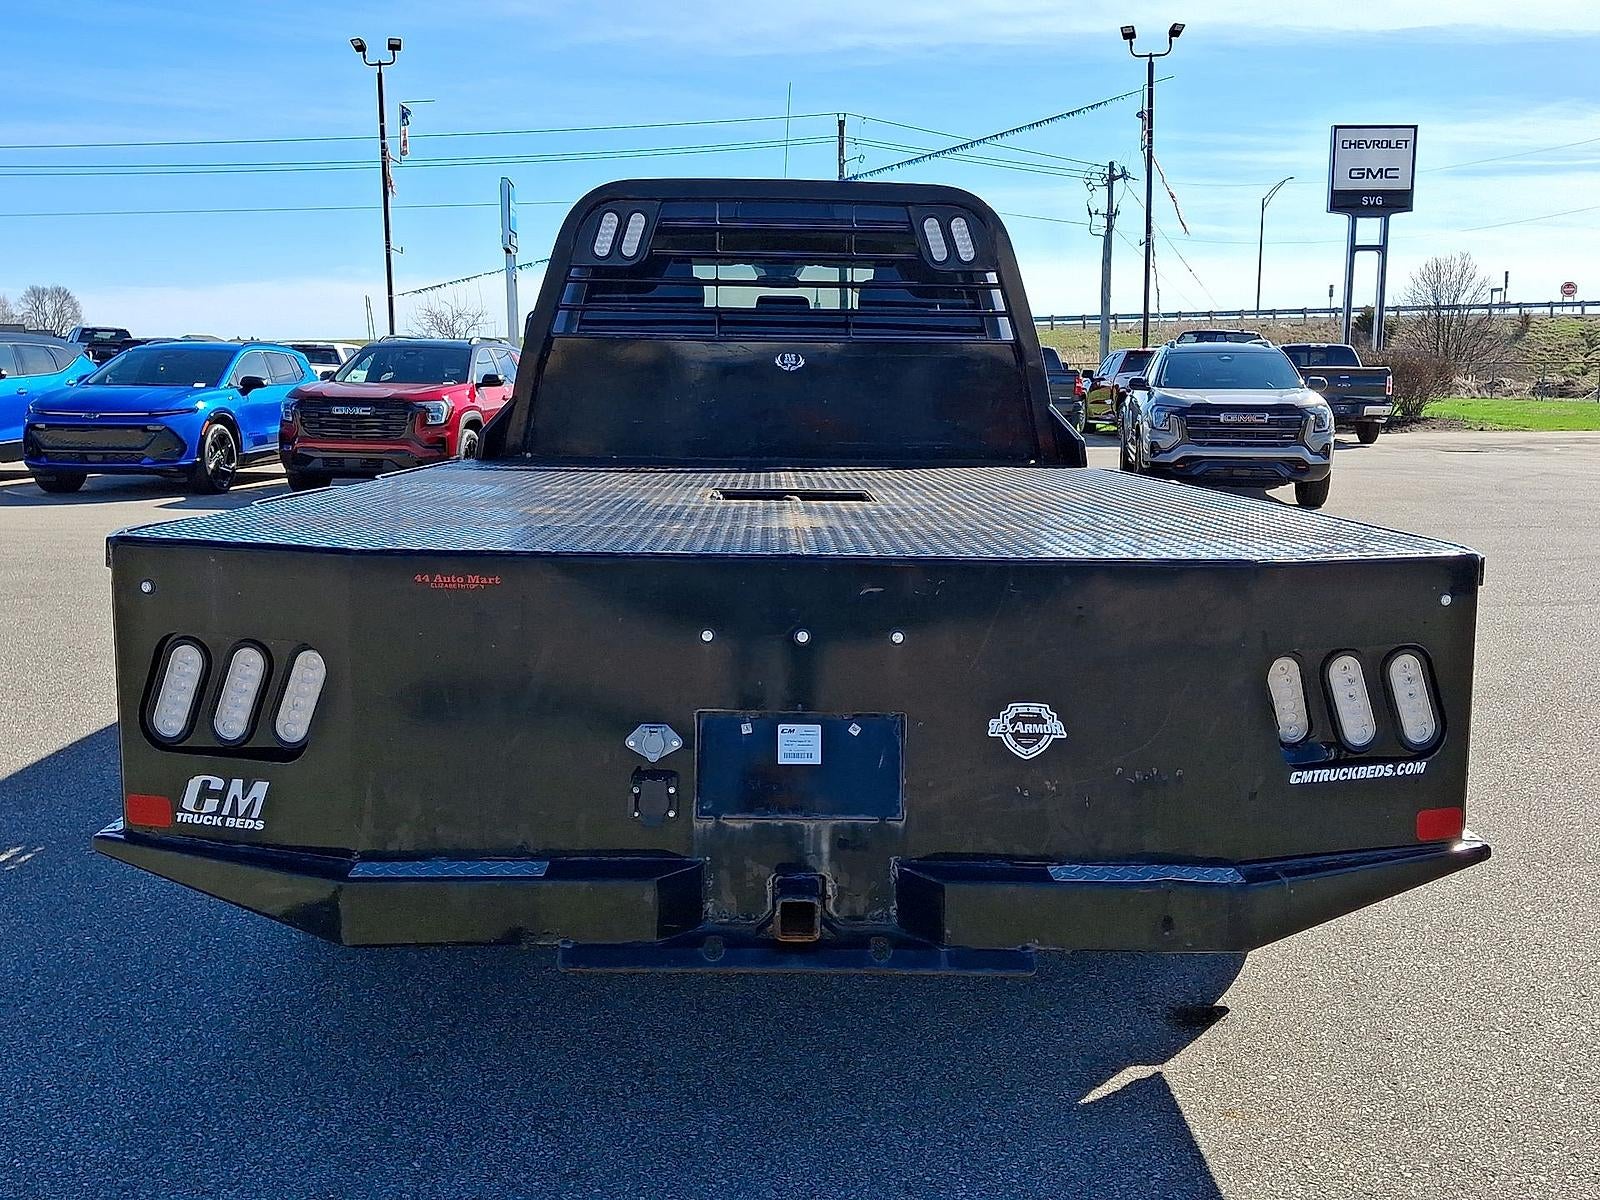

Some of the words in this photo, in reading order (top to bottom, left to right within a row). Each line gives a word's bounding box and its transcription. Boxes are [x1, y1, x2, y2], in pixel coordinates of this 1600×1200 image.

[1341, 139, 1411, 150] CHEVROLET
[1348, 167, 1400, 180] GMC
[1361, 196, 1383, 206] SVG
[331, 406, 371, 415] GMC
[1223, 413, 1266, 424] GMC
[414, 574, 430, 583] 44
[433, 574, 465, 583] Auto
[467, 574, 501, 585] Mart
[1289, 761, 1427, 784] CMTRUCKBEDS.COM
[181, 774, 270, 819] CM
[175, 812, 222, 827] TRUCK
[225, 816, 265, 831] BEDS
